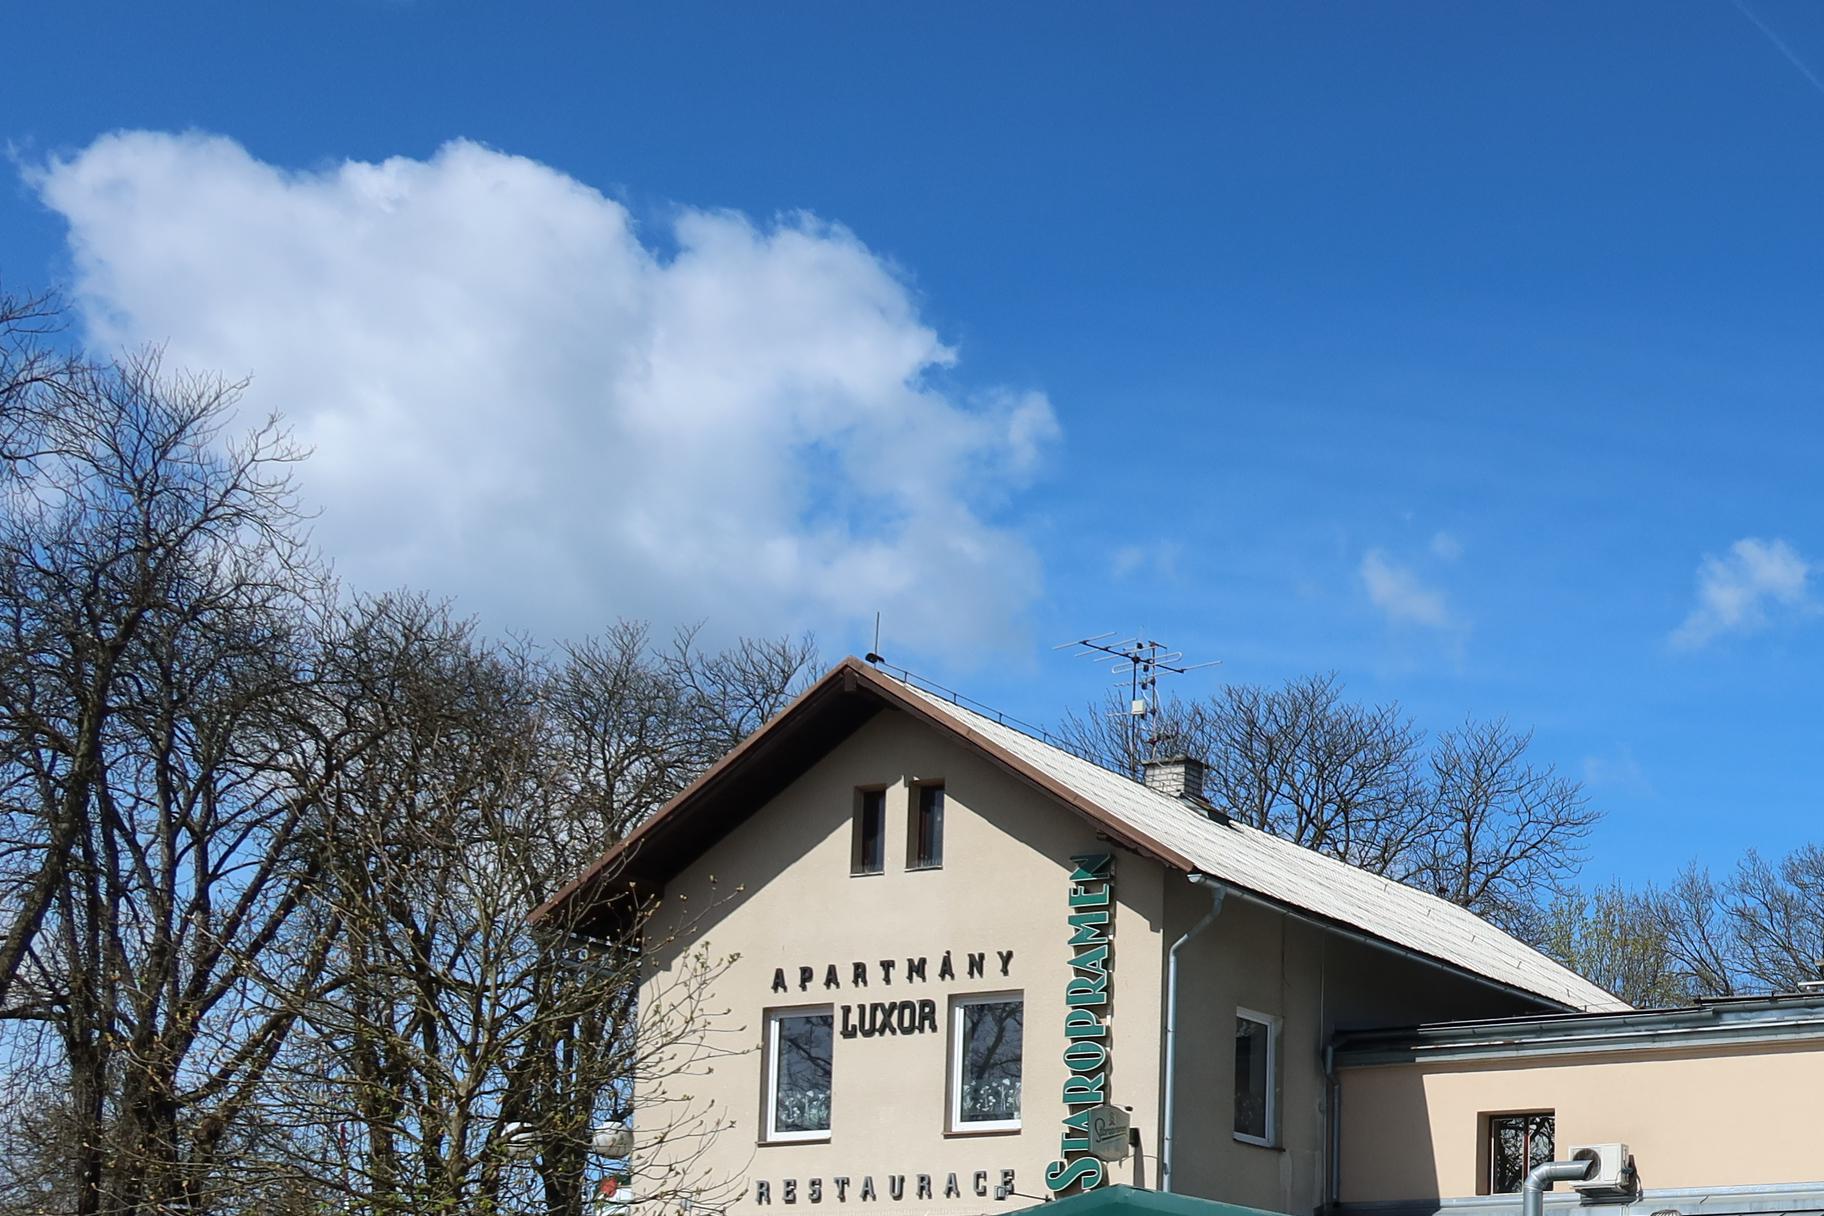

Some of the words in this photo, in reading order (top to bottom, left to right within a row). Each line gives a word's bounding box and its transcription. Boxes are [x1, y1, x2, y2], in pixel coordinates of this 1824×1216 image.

[771, 950, 1014, 994] APARTMÁNY
[840, 998, 937, 1039] LUXOR
[1045, 851, 1113, 1192] STAROPRAMEN
[755, 1168, 1015, 1205] RESTAURACE
